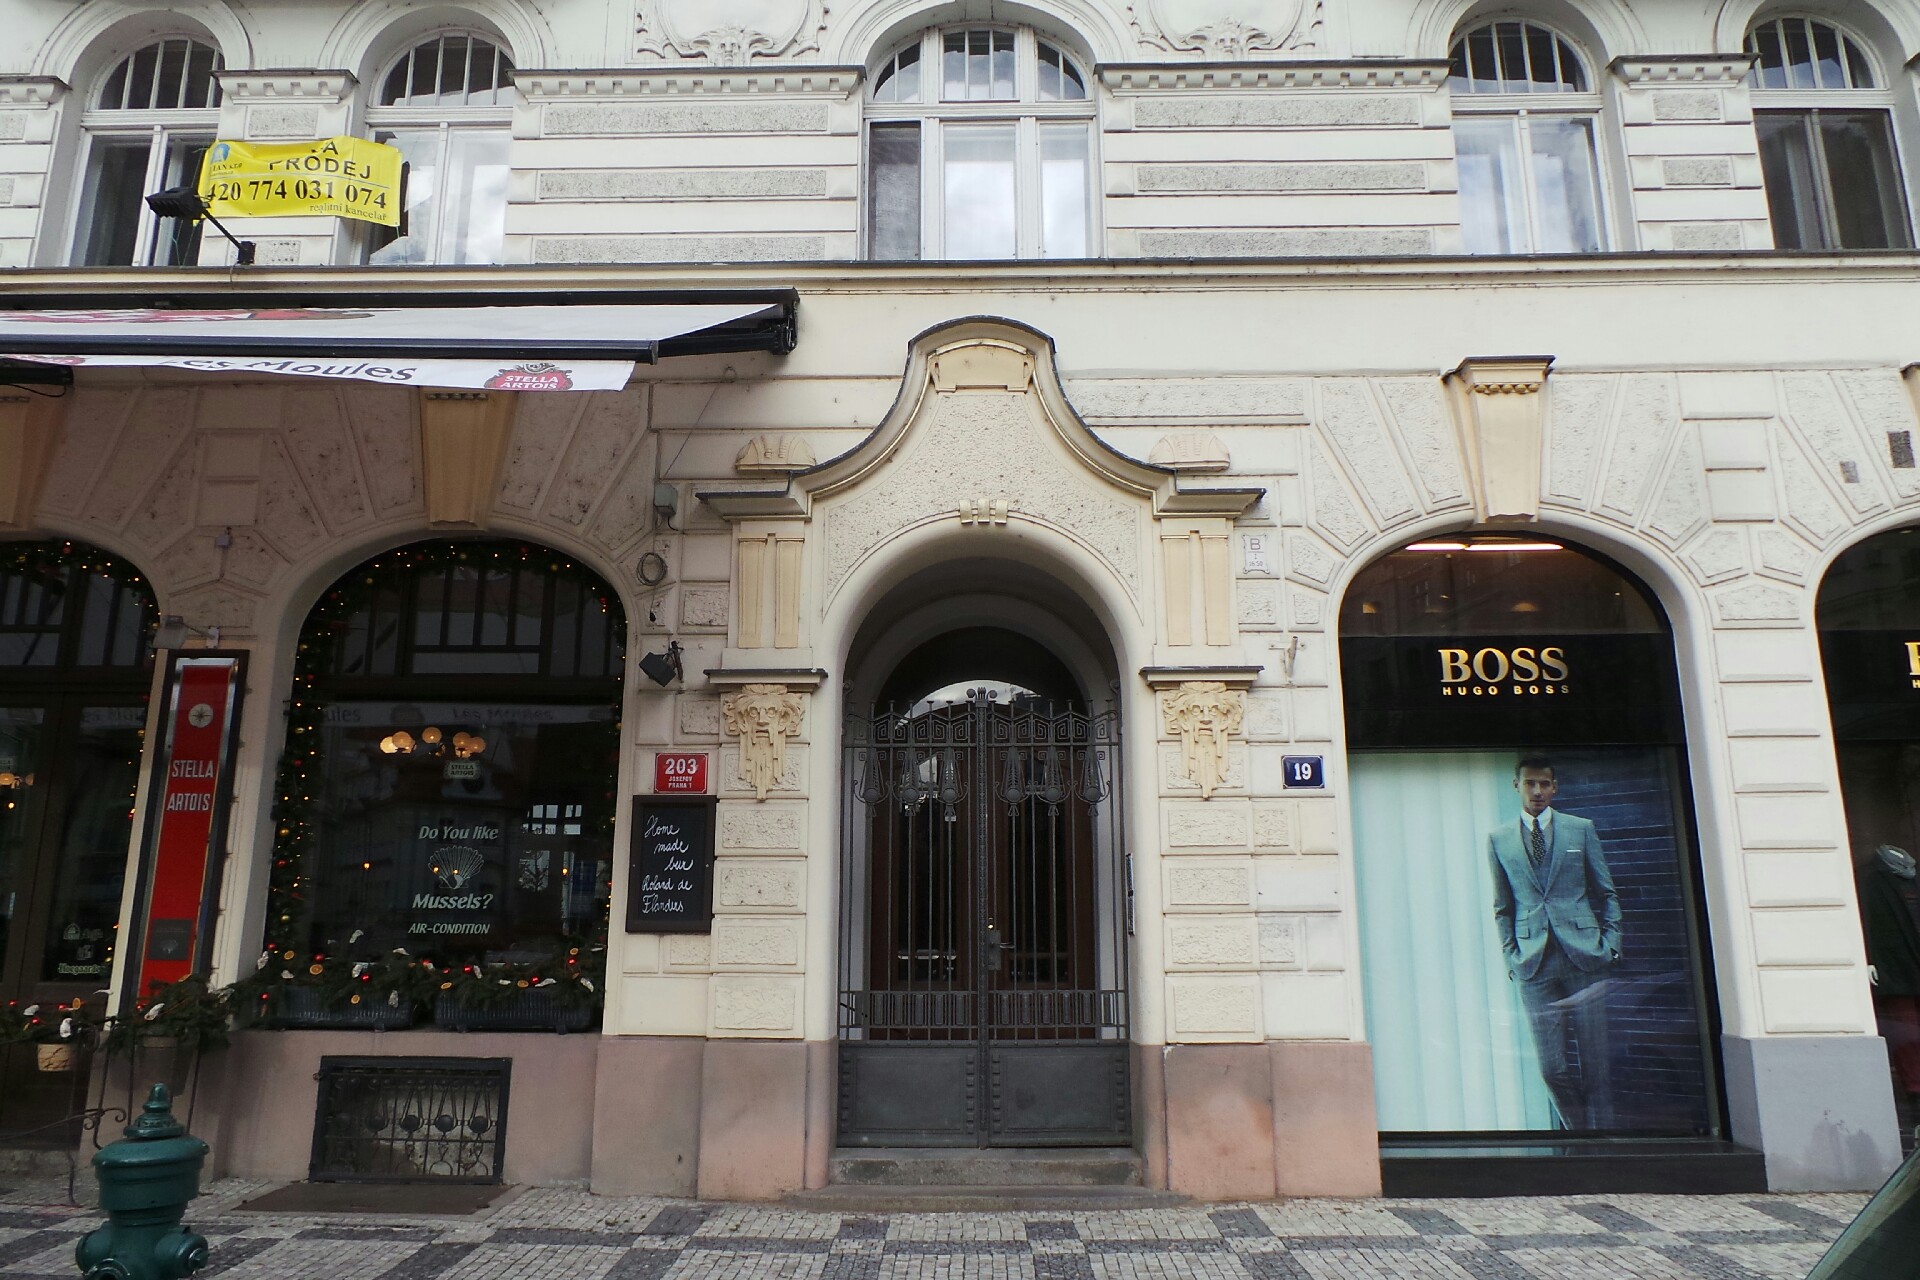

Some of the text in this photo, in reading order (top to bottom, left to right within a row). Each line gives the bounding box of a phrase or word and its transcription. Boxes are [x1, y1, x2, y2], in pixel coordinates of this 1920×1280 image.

[248, 179, 287, 201] 774
[294, 179, 334, 201] 031
[345, 184, 386, 209] 074
[242, 360, 418, 381] Moules
[505, 375, 558, 383] STELLA
[1250, 538, 1260, 550] B
[1438, 647, 1569, 682] BOSS
[1442, 685, 1569, 695] HUGO BOSS
[172, 760, 214, 778] STELLA
[665, 758, 697, 774] 203
[1294, 763, 1312, 780] 19
[167, 793, 210, 811] ARTOIS
[418, 826, 499, 840] Do You like
[644, 814, 680, 839] Home
[653, 838, 689, 855] made
[677, 879, 693, 890] de
[412, 893, 494, 909] Mussels?
[408, 923, 490, 934] AIR-CONDITION
